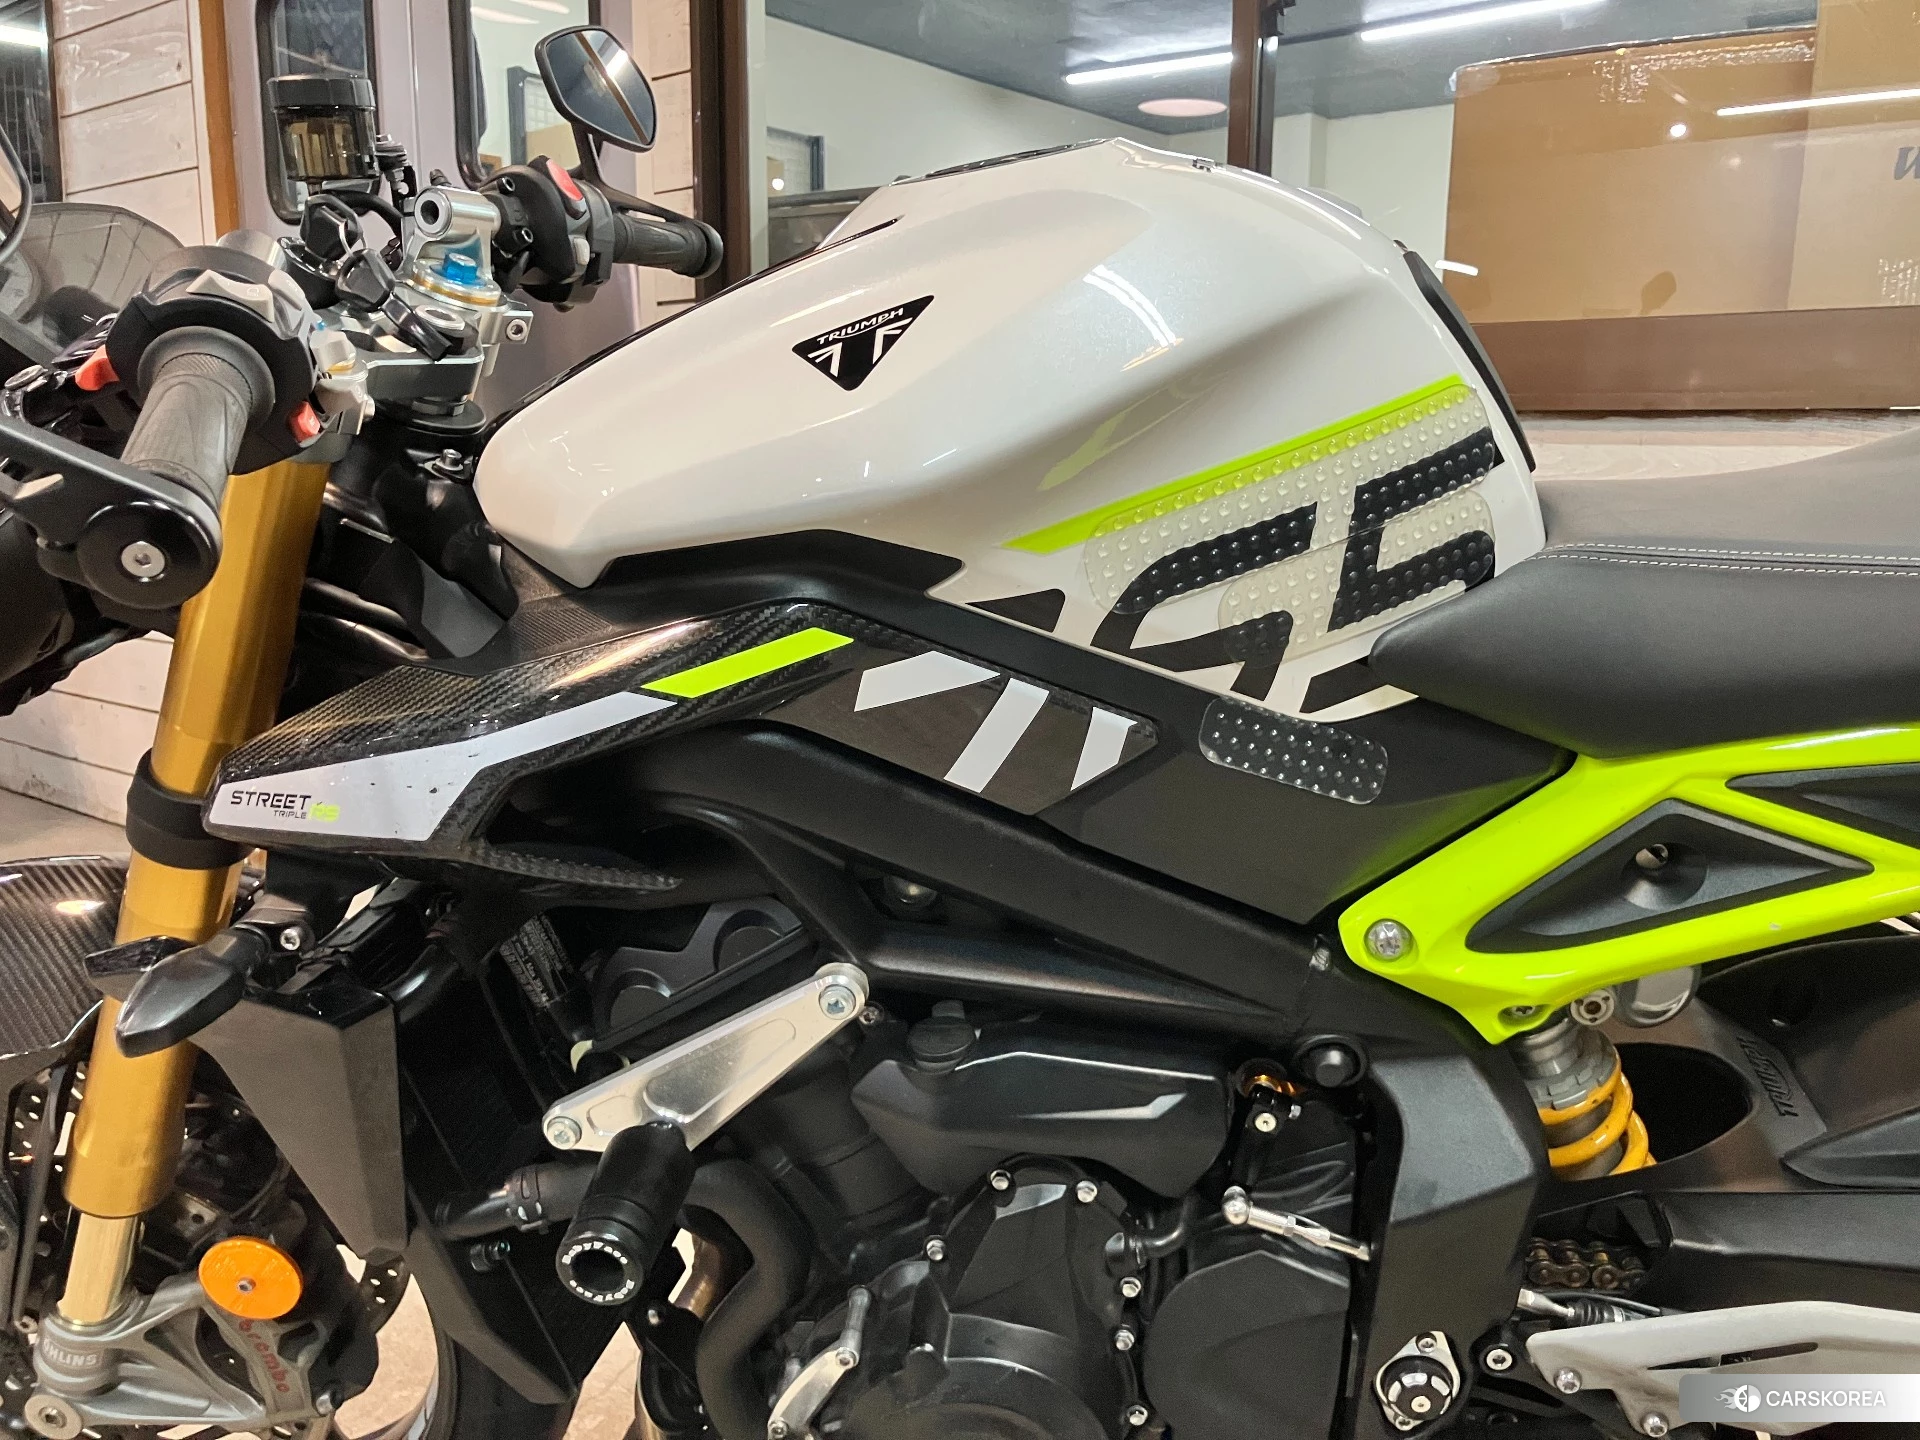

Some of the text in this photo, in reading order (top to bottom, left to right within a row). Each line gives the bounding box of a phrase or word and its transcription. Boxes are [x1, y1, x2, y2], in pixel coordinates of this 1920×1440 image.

[816, 307, 904, 345] TRIUMPH
[230, 790, 312, 810] STREET
[273, 809, 307, 820] TRIPLE
